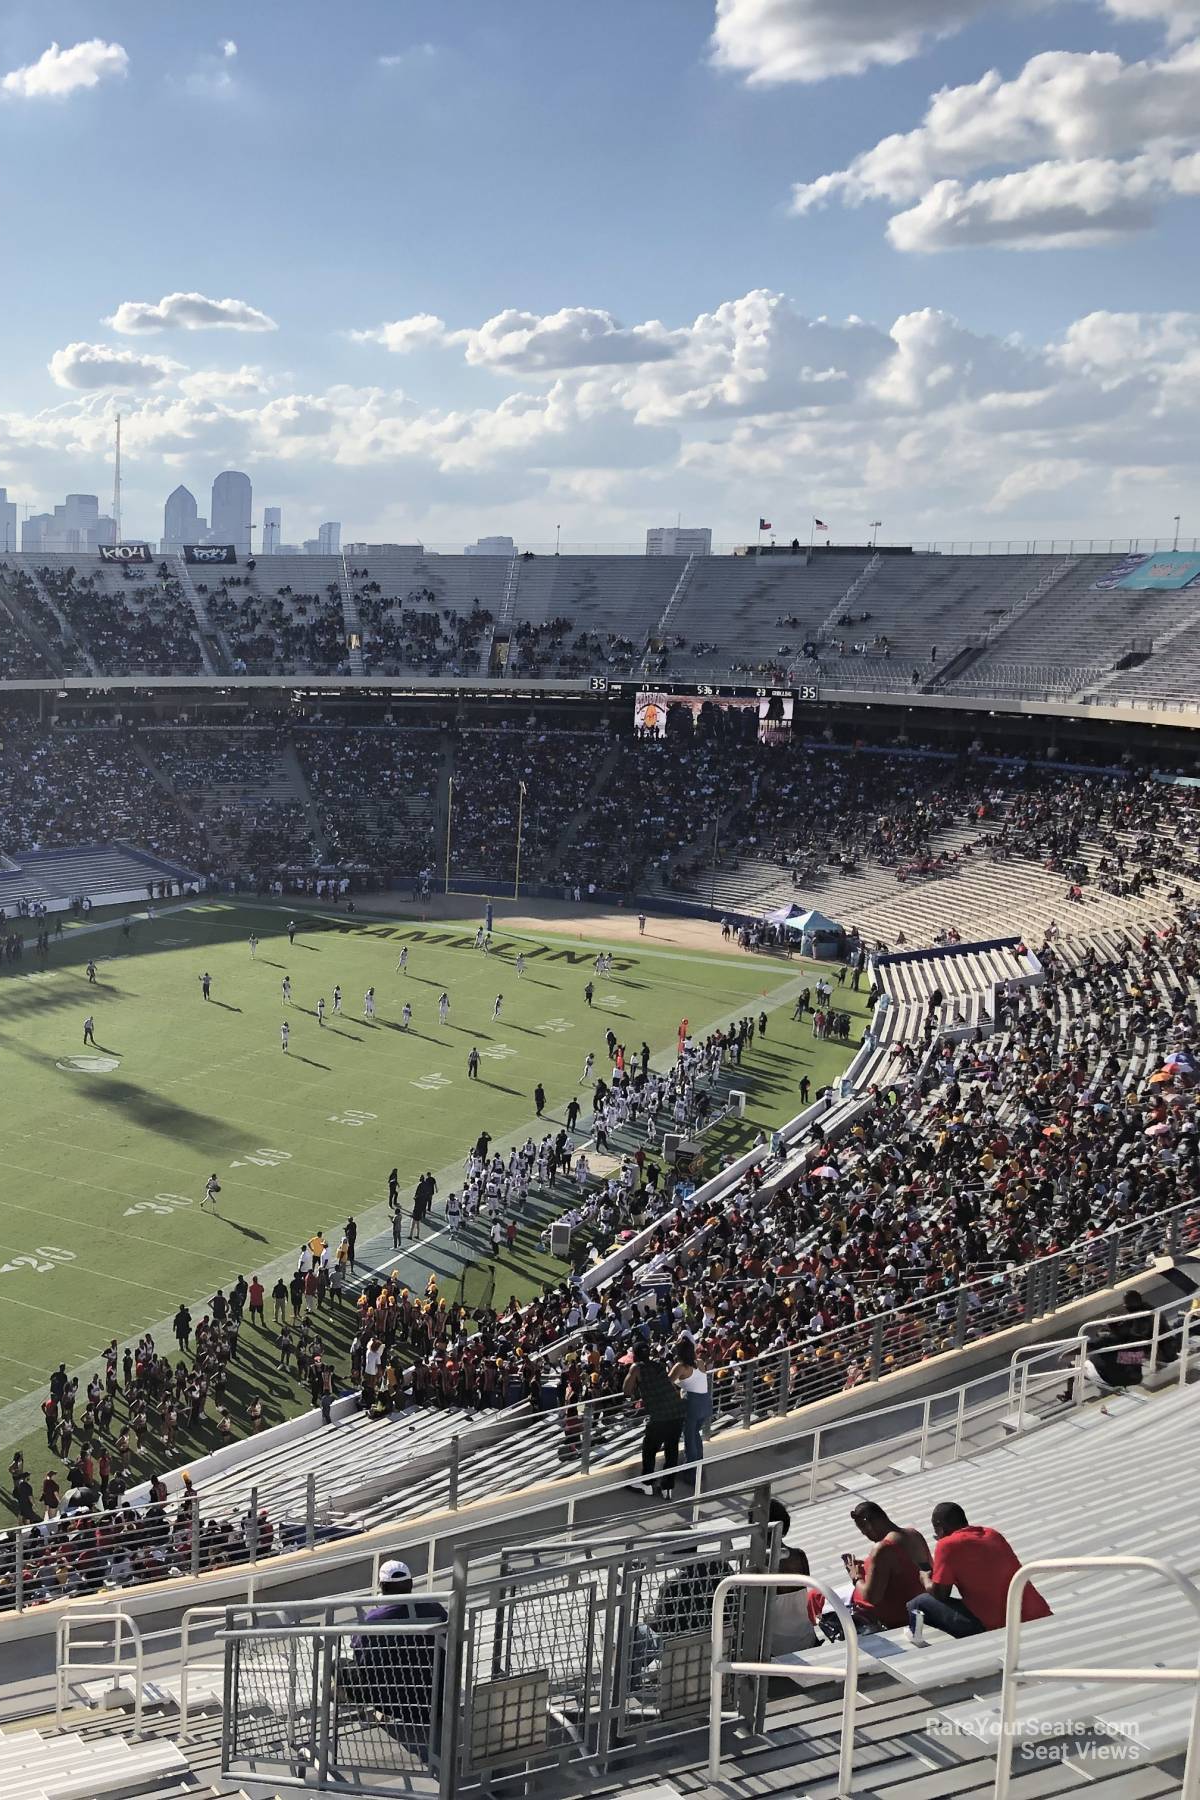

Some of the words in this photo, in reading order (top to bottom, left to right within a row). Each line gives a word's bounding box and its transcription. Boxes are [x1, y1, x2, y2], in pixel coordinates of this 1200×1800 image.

[592, 678, 605, 690] 35
[697, 685, 712, 695] 5:36
[756, 688, 767, 697] 23
[802, 686, 816, 698] 35
[294, 918, 640, 972] GRAMBLING
[326, 1109, 379, 1128] 50
[242, 1147, 294, 1168] 40
[133, 1193, 194, 1216] 30
[11, 1246, 78, 1273] 20
